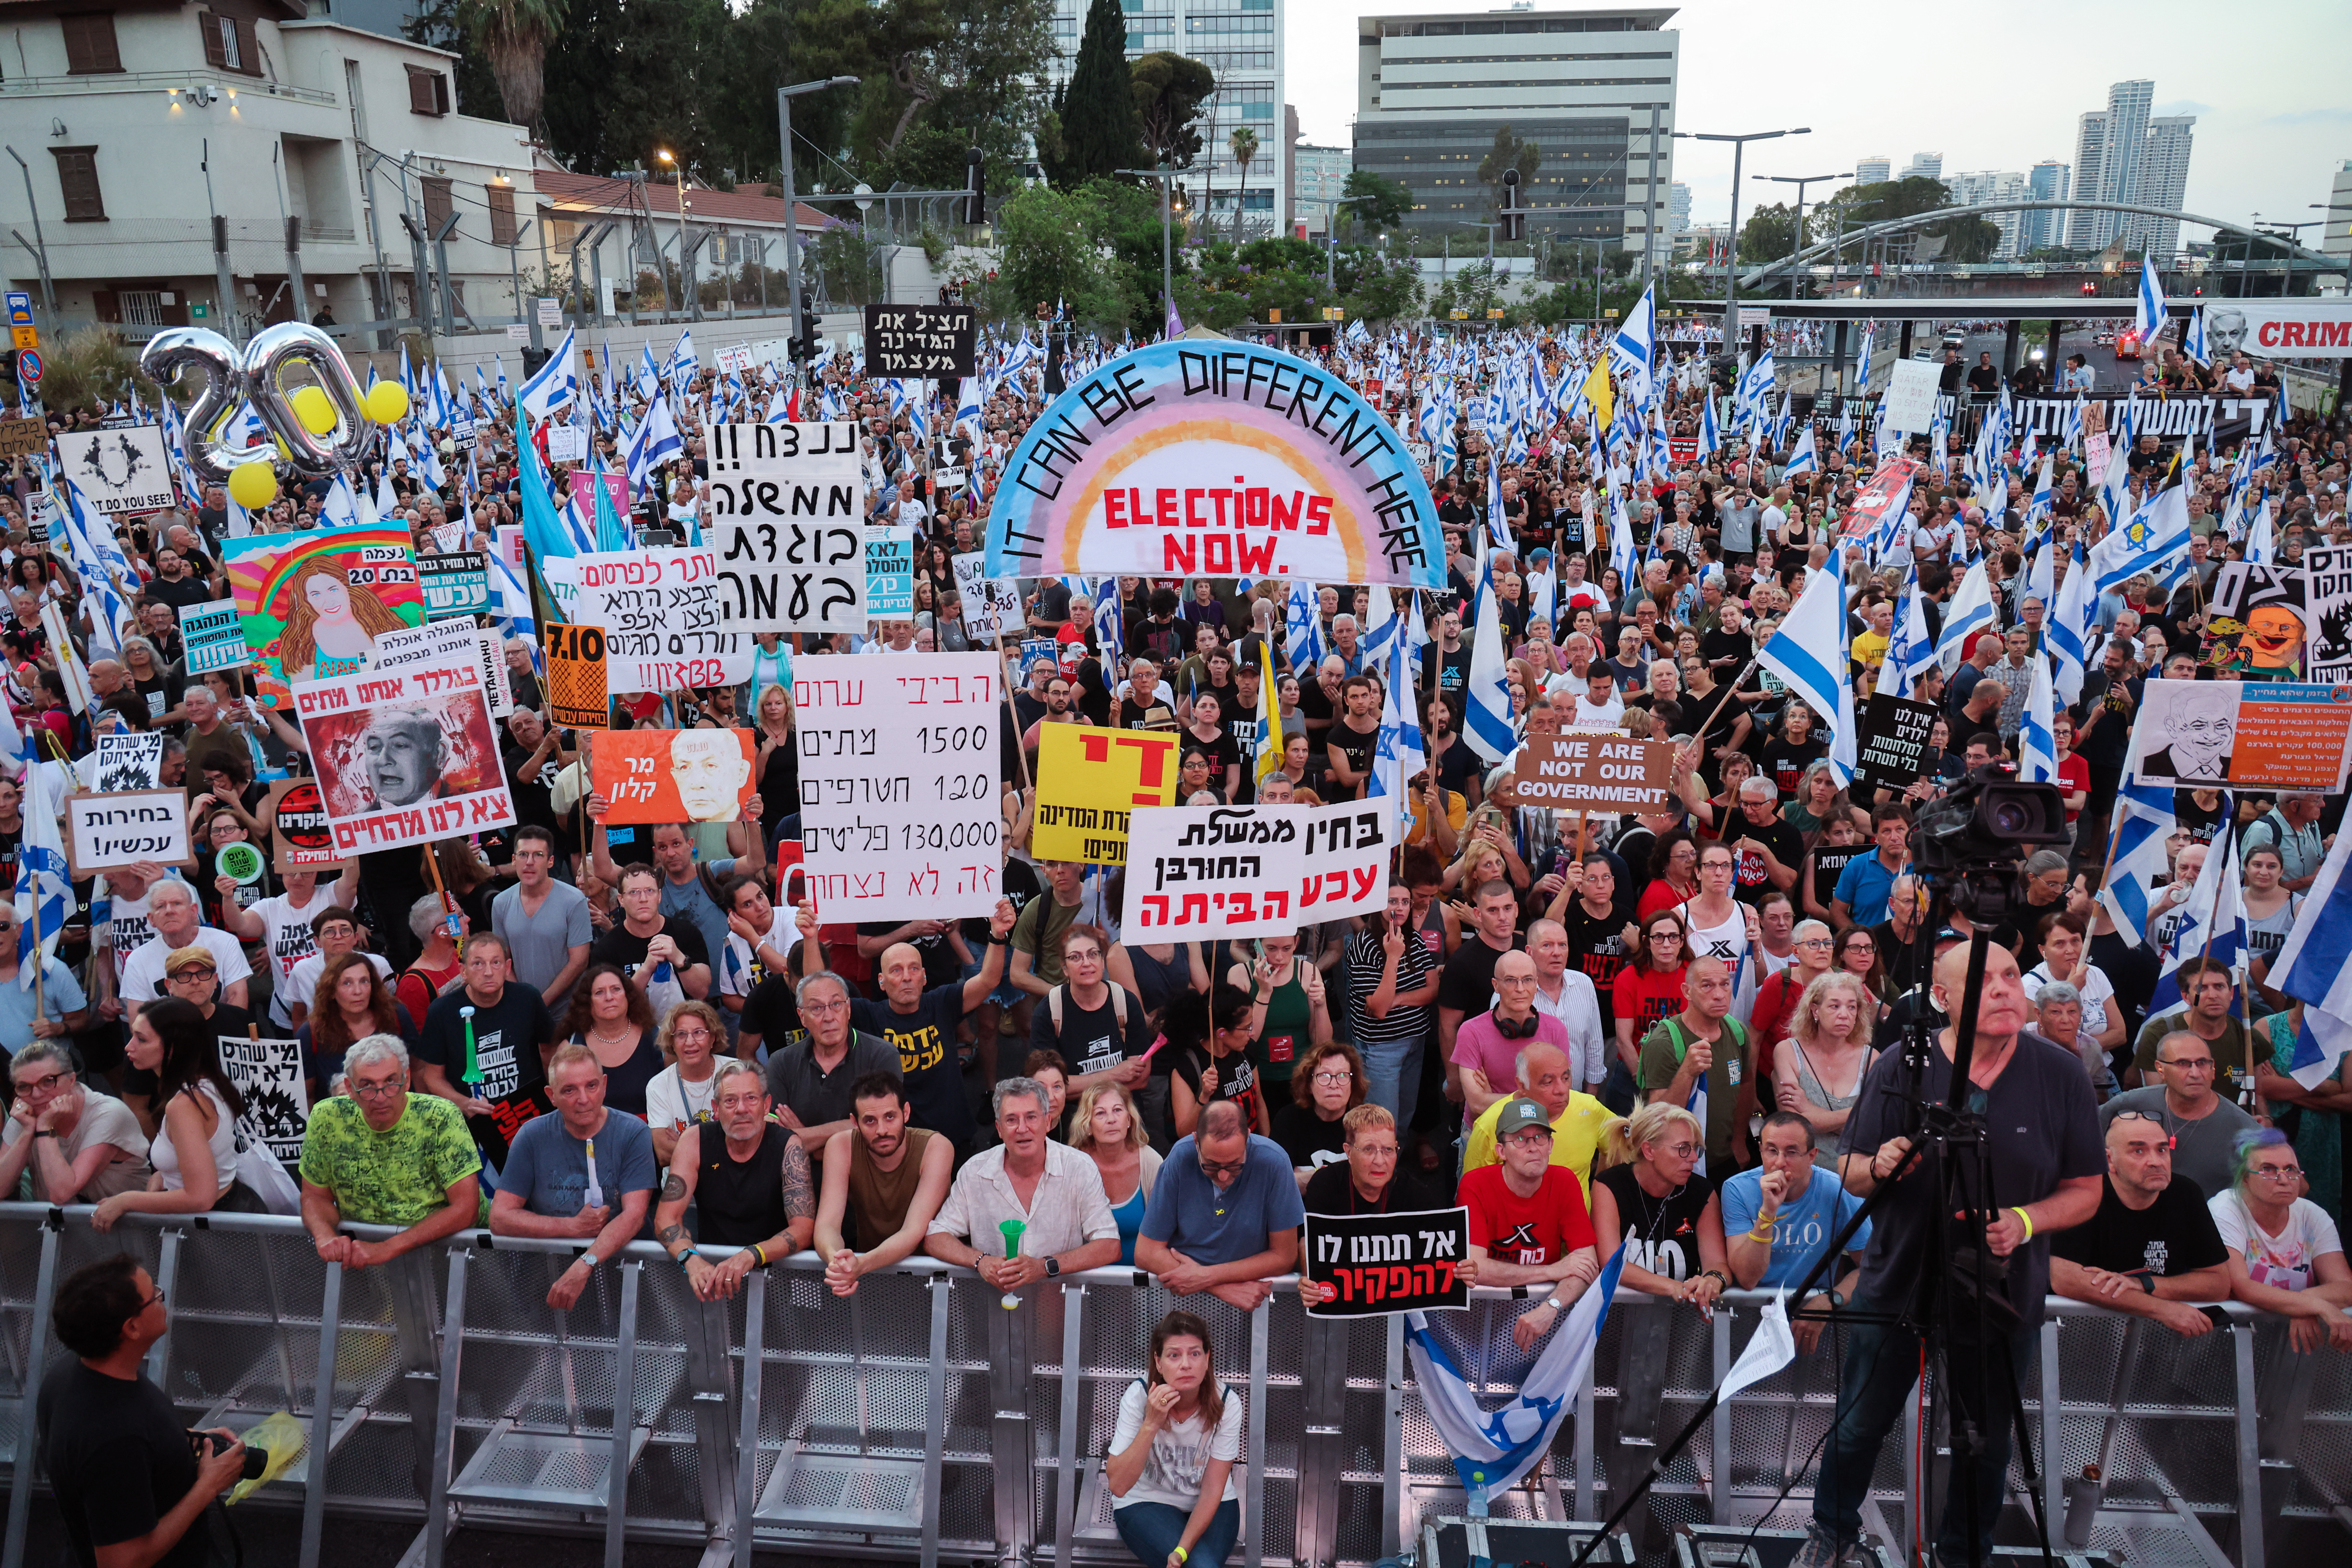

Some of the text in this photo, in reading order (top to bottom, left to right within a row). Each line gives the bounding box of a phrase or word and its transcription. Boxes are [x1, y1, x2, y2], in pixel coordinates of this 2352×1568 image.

[874, 313, 968, 332] תציל את
[880, 332, 955, 350] המדינה
[880, 353, 956, 371] מעצמך
[1904, 364, 1927, 373] DOES
[1892, 385, 1907, 395] PAY
[1897, 374, 1929, 387] QATAR
[141, 321, 367, 486] 20
[1904, 399, 1918, 407] SIT
[1920, 402, 1932, 412] ON
[1890, 410, 1928, 424] HIS ASS?
[2109, 395, 2216, 436] לממשלת
[1, 434, 45, 454] לשלום
[453, 431, 474, 439] בחירות
[456, 437, 475, 450] עכשיו!
[714, 424, 857, 471] ננצח!!
[1001, 350, 1427, 574] IT CAN BE DIFFERENT HERE
[936, 469, 948, 478] Going
[106, 493, 171, 510] DO YOU SEE?
[712, 478, 853, 517] ממשלה
[364, 547, 406, 560] נעמה
[725, 523, 857, 565] בוגדת
[878, 541, 899, 557] לא
[1163, 533, 1289, 575] NOW.
[443, 556, 482, 570] אין מחיר
[579, 554, 662, 587] לפרסום:
[350, 569, 414, 583] בת 20
[441, 572, 485, 586] הצילו את
[882, 577, 897, 593] כן
[601, 588, 661, 613] הירואי
[717, 571, 857, 621] בעמה
[883, 596, 911, 609] לברית
[613, 606, 667, 631] אלפי
[187, 630, 228, 647] החטופים
[382, 620, 474, 650] המוגלה אוכלת
[546, 624, 605, 662] 7.10
[606, 632, 660, 656] מגיוס
[383, 637, 472, 667] אותנו מבפנים
[1021, 641, 1054, 654] בחירות
[479, 640, 500, 712] NETANYAHU
[300, 666, 478, 714] בגללך אנחנו מתים
[794, 676, 989, 707] הביבי ערום
[552, 707, 606, 725] בחירות עכשיו!
[1895, 708, 1932, 727] אין לנו
[100, 734, 160, 749] מי שהרס
[802, 725, 987, 756] 1500 מתים
[1896, 725, 1927, 741] ילדים
[1553, 741, 1645, 761] WE ARE
[1871, 735, 1923, 757] למלחמות
[100, 749, 159, 766] לא יתקן
[624, 756, 655, 773] מר
[1862, 748, 1919, 772] בלי מטרות
[1540, 760, 1646, 781] NOT OUR
[610, 777, 657, 804] קלון
[802, 774, 988, 804] 120 חטופים
[1517, 780, 1666, 804] GOVERNMENT
[86, 808, 173, 826] בחירות
[334, 793, 510, 849] צא לנו מהחיים
[1040, 804, 1097, 830] המדינה
[803, 815, 888, 853] פליטים
[1178, 809, 1296, 847] ממשלת
[94, 836, 171, 856] עכשיו!
[227, 850, 247, 860] גיוס
[297, 849, 329, 862] מחילה
[230, 857, 249, 867] שווה
[807, 862, 995, 914] זה לא נצחון
[1594, 943, 1615, 955] הביתה
[222, 1041, 298, 1062] מי שהרס
[226, 1061, 298, 1082] לא יתקן
[1317, 1230, 1456, 1263] אל תתנו לו
[1333, 1260, 1457, 1303] להפקיר
